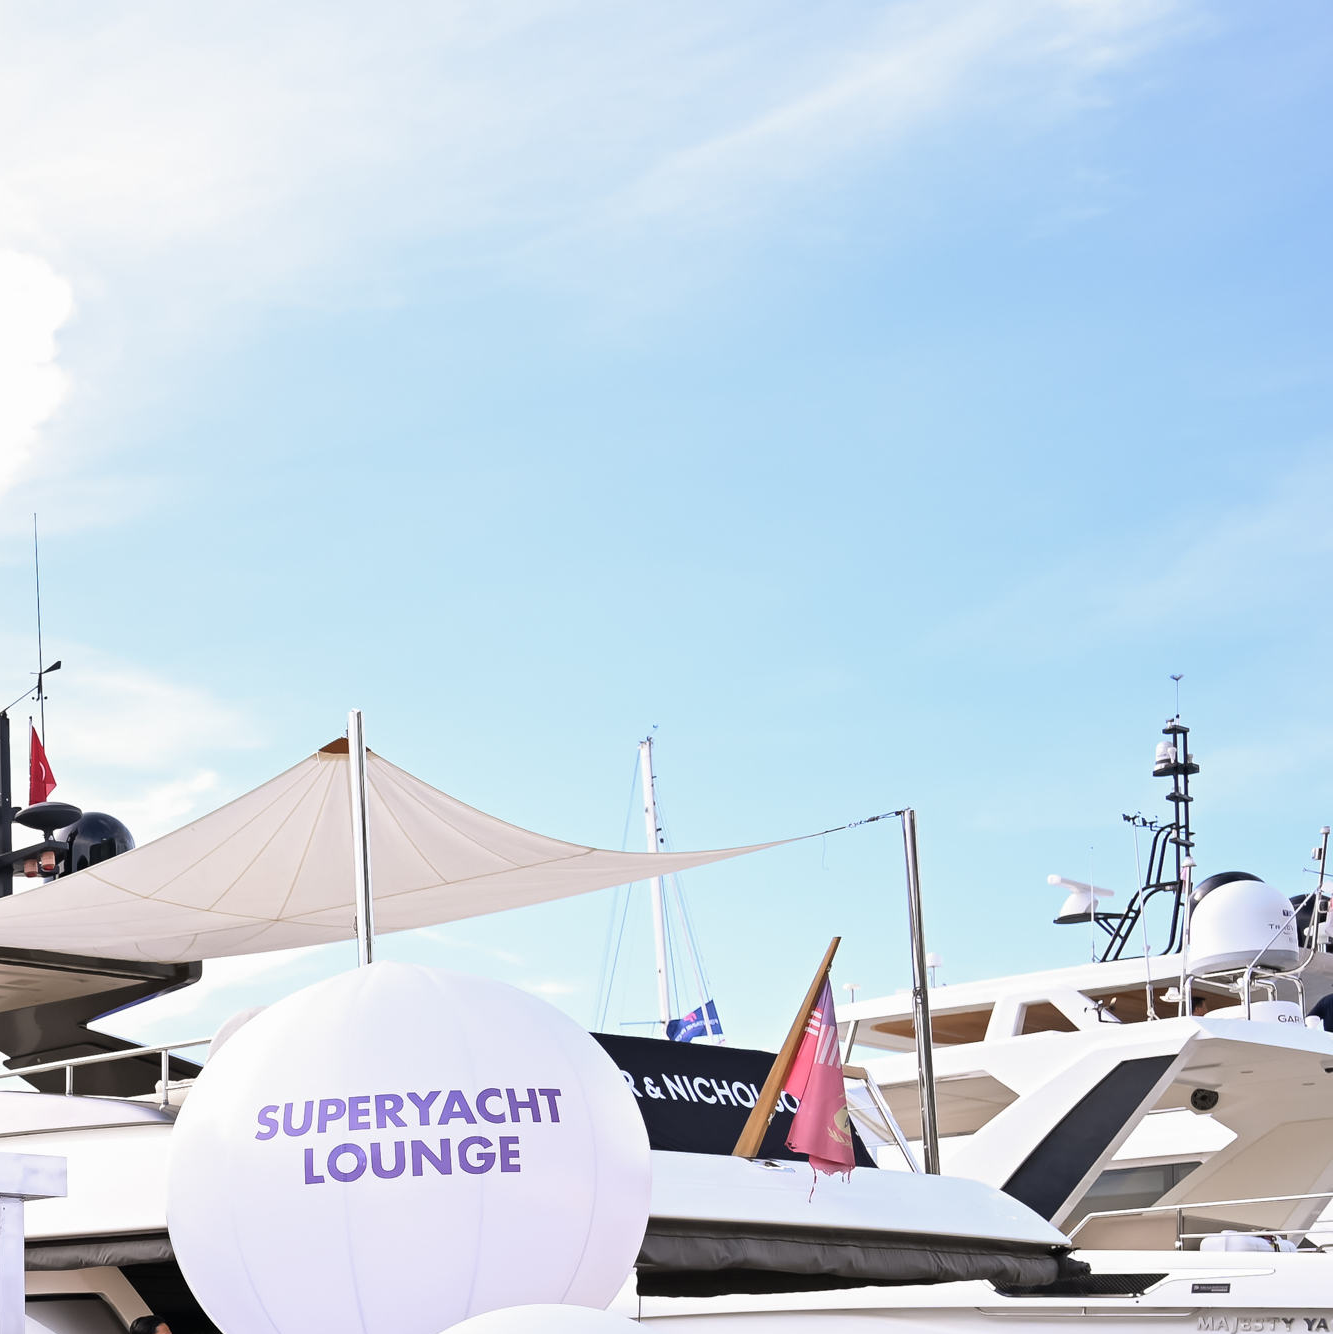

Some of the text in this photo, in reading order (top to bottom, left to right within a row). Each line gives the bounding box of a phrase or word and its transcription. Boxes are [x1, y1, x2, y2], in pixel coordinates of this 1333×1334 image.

[1278, 1014, 1302, 1024] GAR
[643, 1076, 666, 1099] &
[255, 1087, 562, 1140] SUPERYACHT
[304, 1136, 521, 1184] LOUNGE
[1196, 1316, 1295, 1334] MAJESTY
